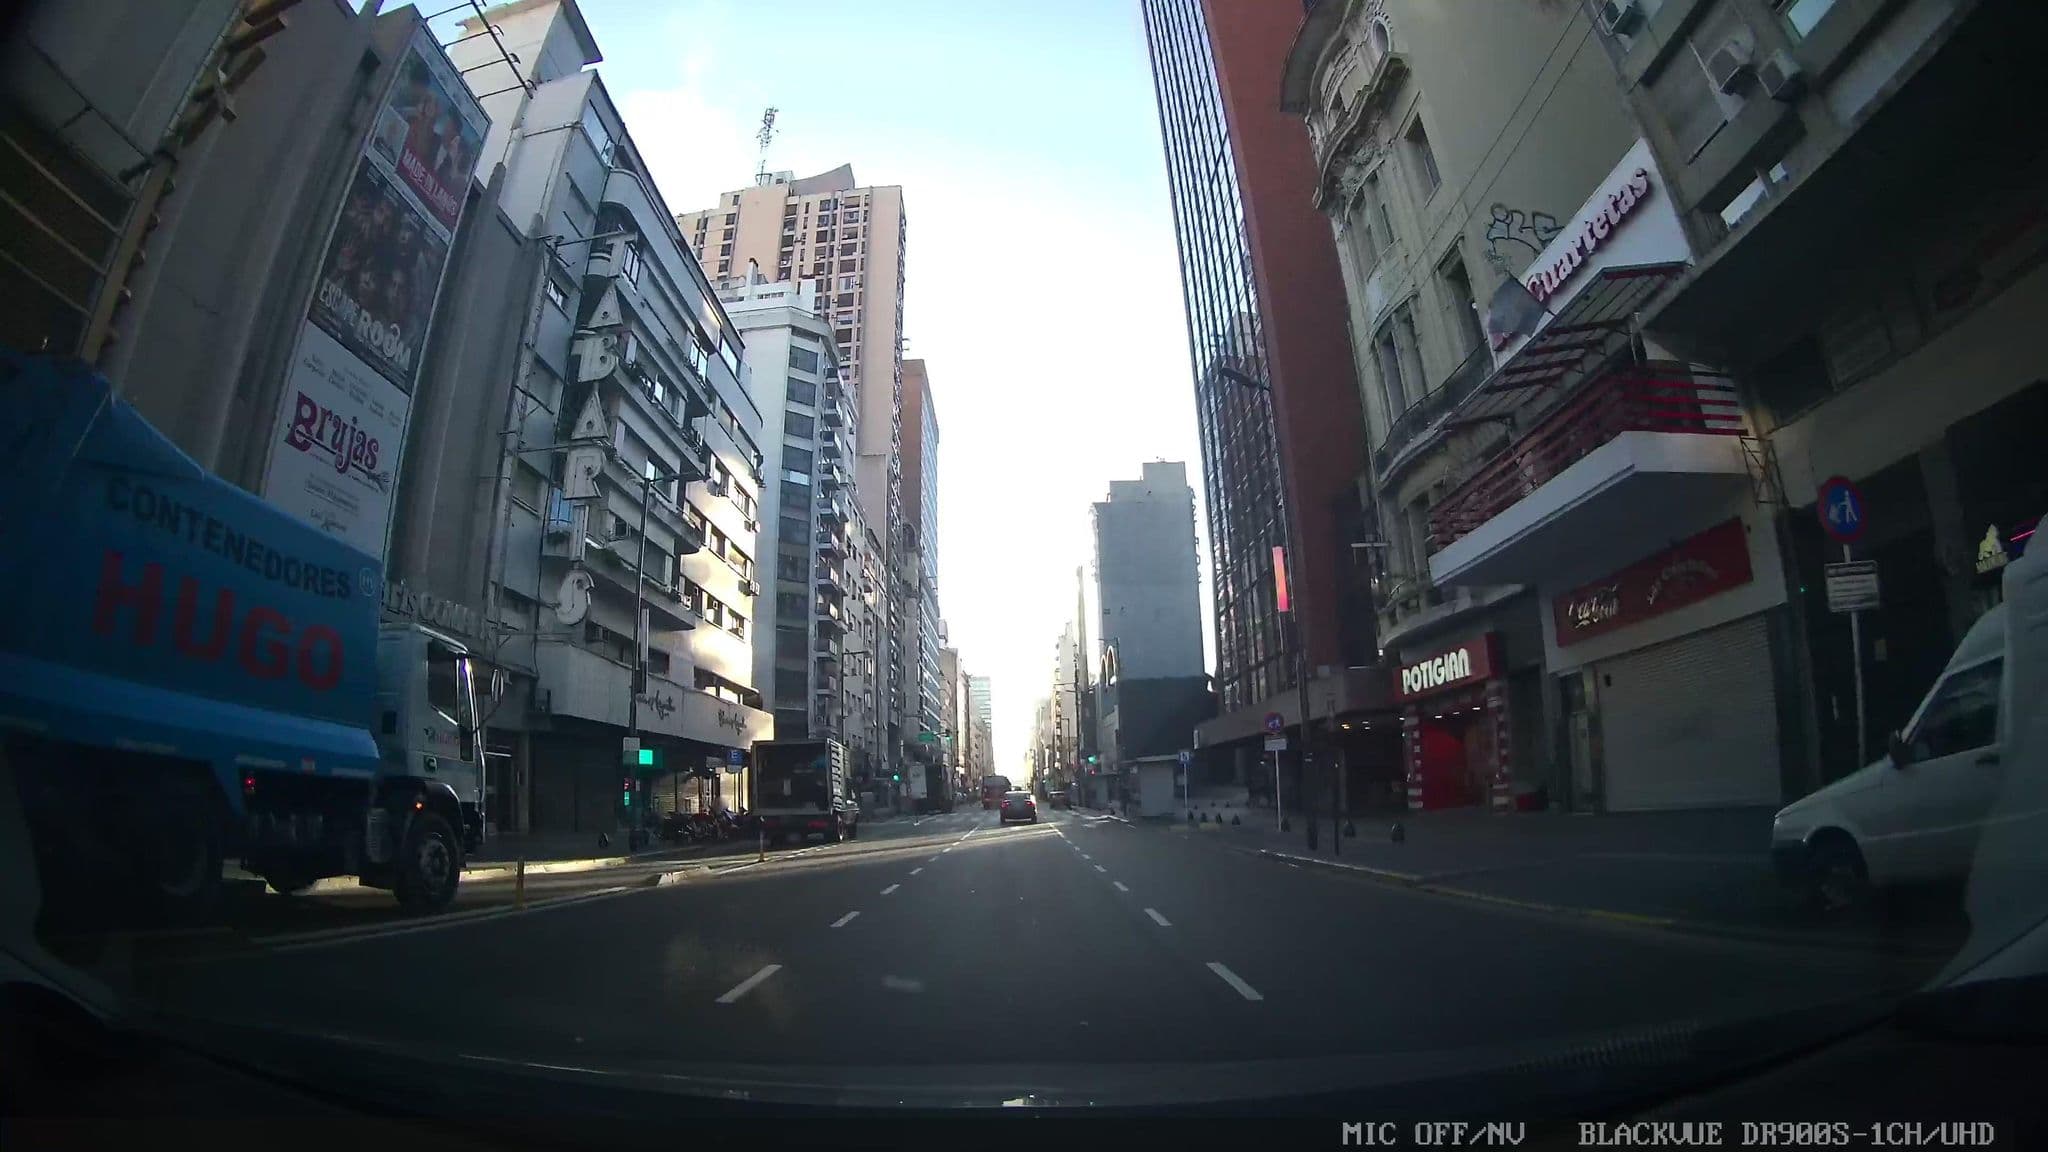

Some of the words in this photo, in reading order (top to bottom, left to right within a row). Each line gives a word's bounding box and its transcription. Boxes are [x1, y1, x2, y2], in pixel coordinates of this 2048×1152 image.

[401, 148, 427, 185] MADE
[1526, 168, 1650, 302] Cuartetas
[358, 308, 413, 372] ROOM
[285, 391, 380, 474] Brujas
[108, 476, 352, 600] CONTENEDORES
[92, 547, 346, 692] HUGO
[1400, 647, 1471, 696] POTIGIAN
